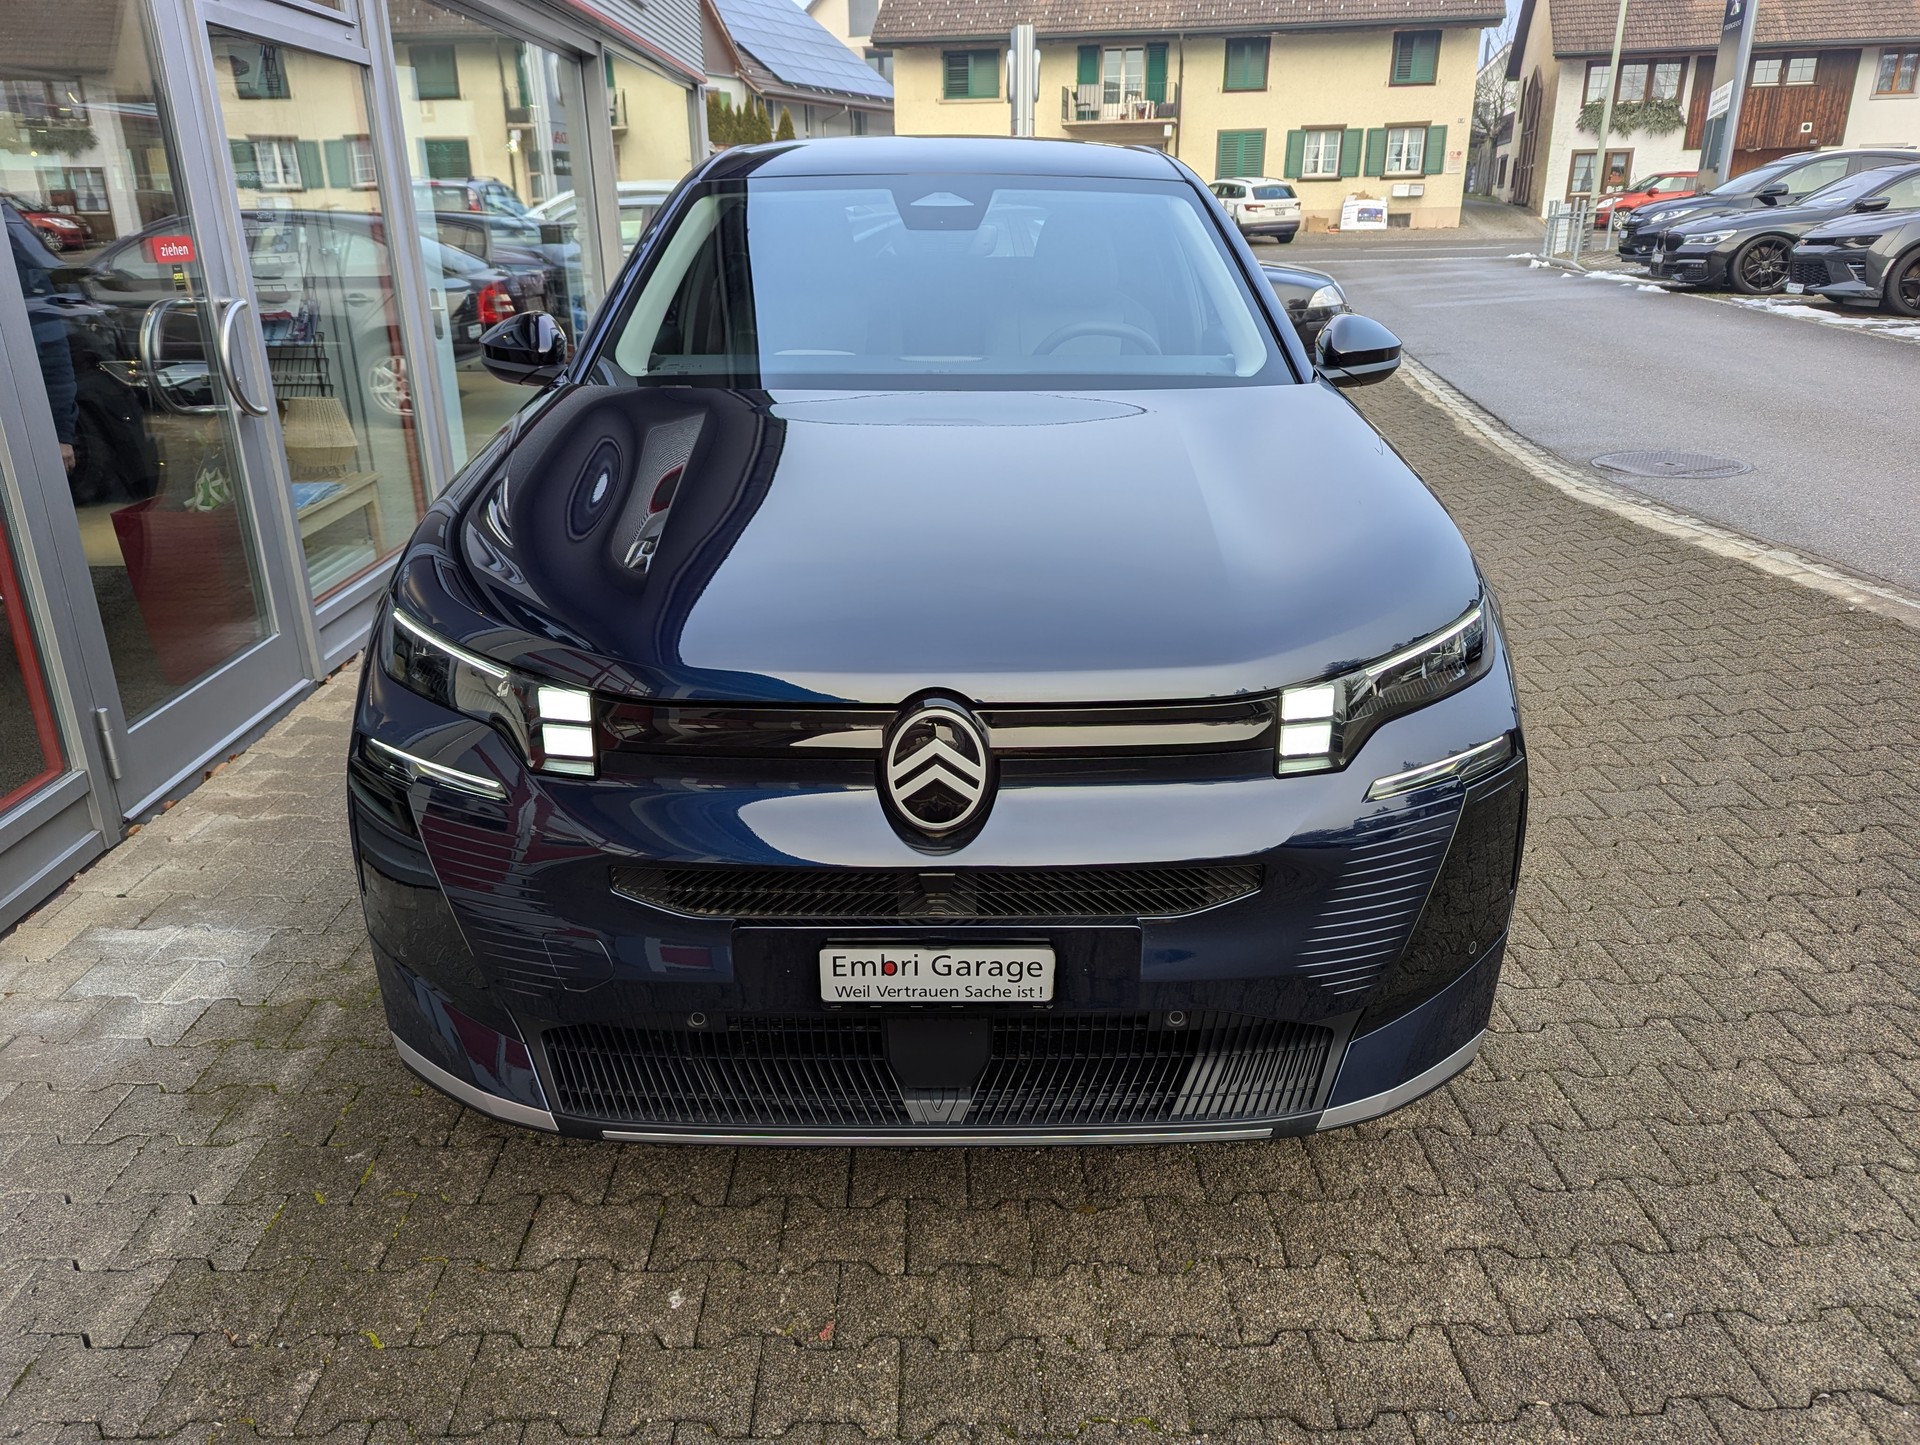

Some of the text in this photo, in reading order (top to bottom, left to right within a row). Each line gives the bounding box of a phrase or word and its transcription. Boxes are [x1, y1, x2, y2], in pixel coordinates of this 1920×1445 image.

[161, 242, 189, 256] ziehen
[832, 954, 1043, 983] Embri Garage
[835, 985, 870, 998] Weil
[876, 985, 959, 998] Vertrauen
[965, 985, 1012, 998] Sache
